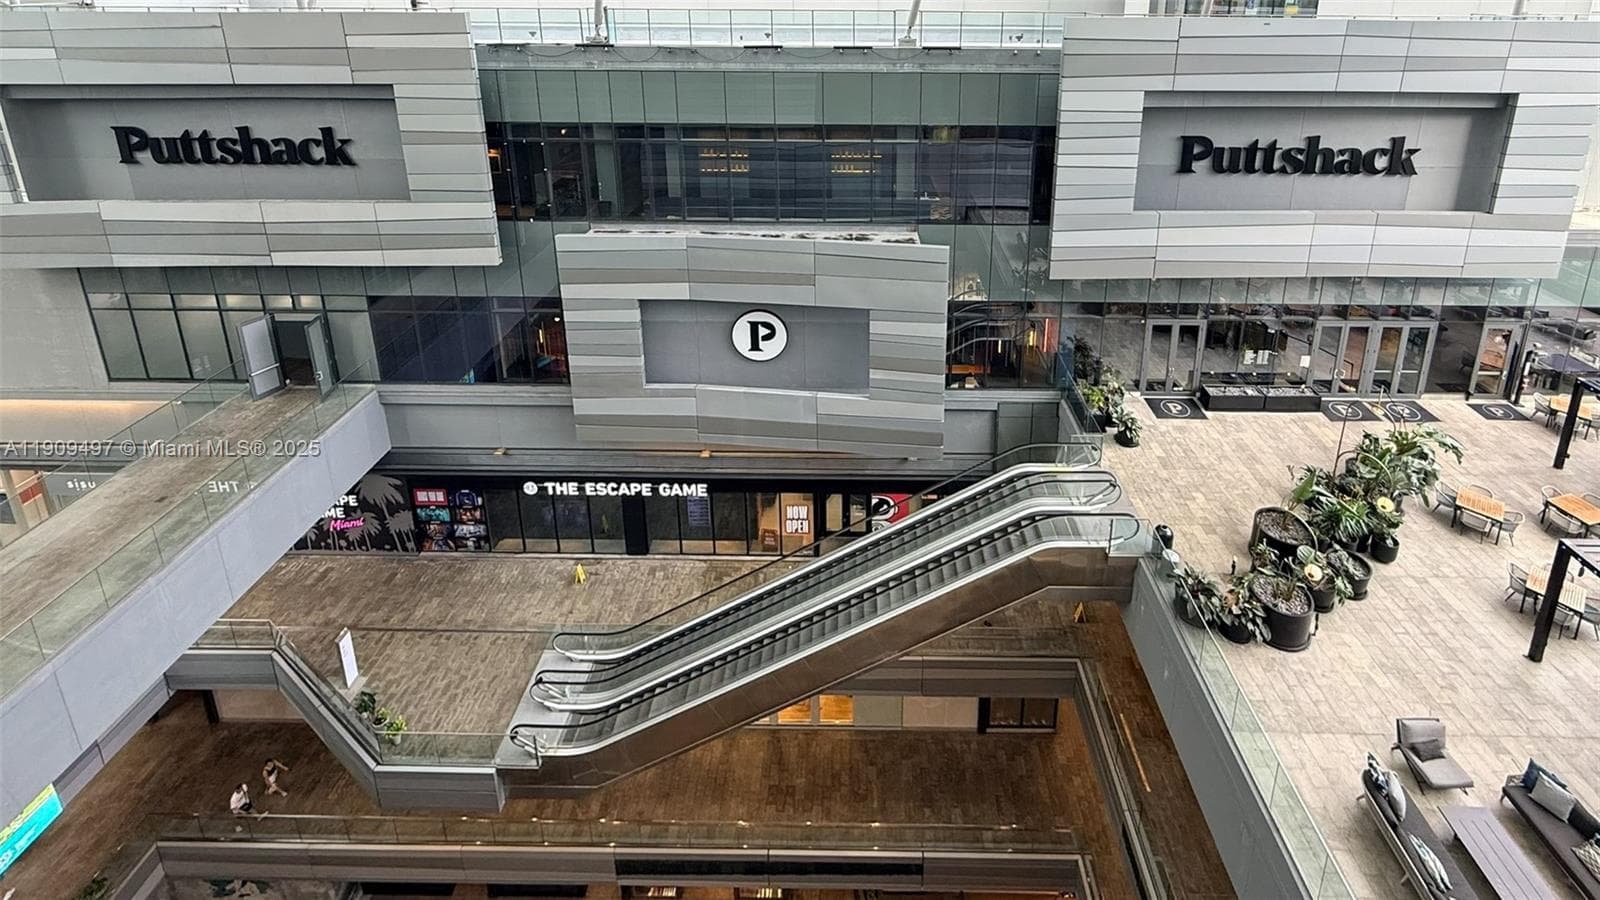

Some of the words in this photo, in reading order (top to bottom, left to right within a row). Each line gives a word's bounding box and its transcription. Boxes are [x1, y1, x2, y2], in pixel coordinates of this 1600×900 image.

[110, 125, 357, 167] Puttshack
[1177, 135, 1421, 177] Puttshack
[747, 321, 776, 352] P
[544, 482, 579, 496] THE
[585, 482, 652, 497] ESCAPE
[658, 483, 708, 497] GAME
[786, 505, 808, 519] NOW
[329, 517, 364, 532] Miami
[786, 520, 809, 533] OPEN
